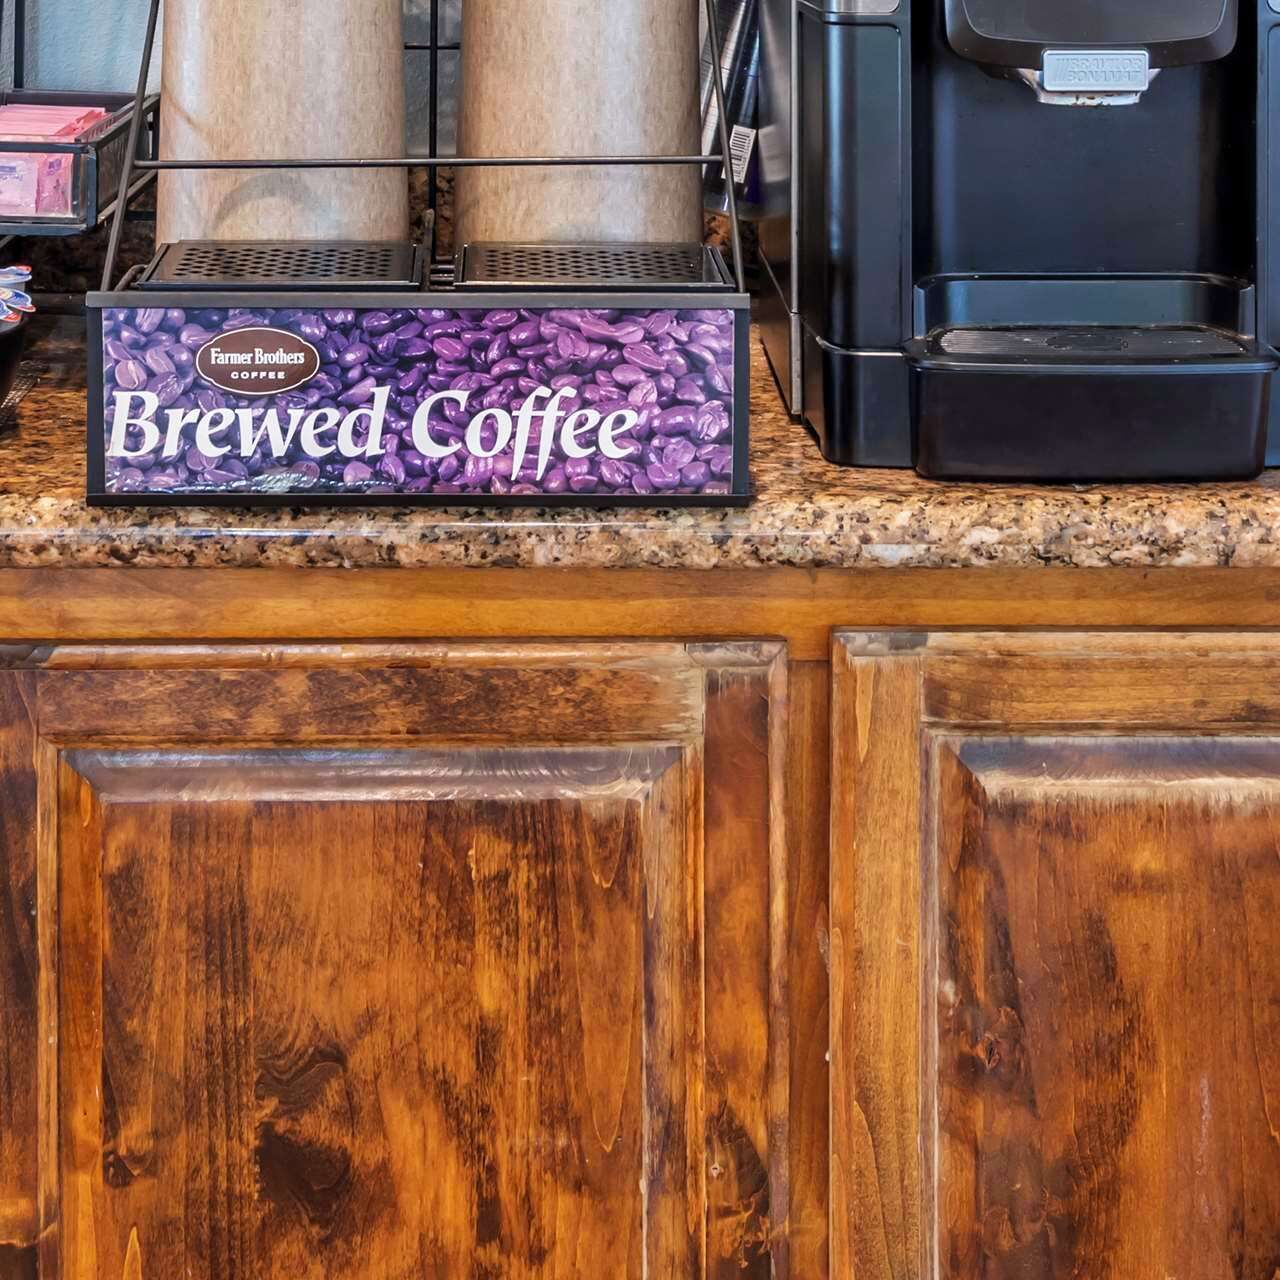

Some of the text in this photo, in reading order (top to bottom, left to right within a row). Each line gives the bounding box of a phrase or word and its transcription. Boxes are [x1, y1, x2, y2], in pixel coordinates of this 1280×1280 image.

[210, 348, 305, 365] Farmer Brothers
[231, 371, 285, 379] COFFEE
[106, 387, 639, 481] Brewed Coffee
